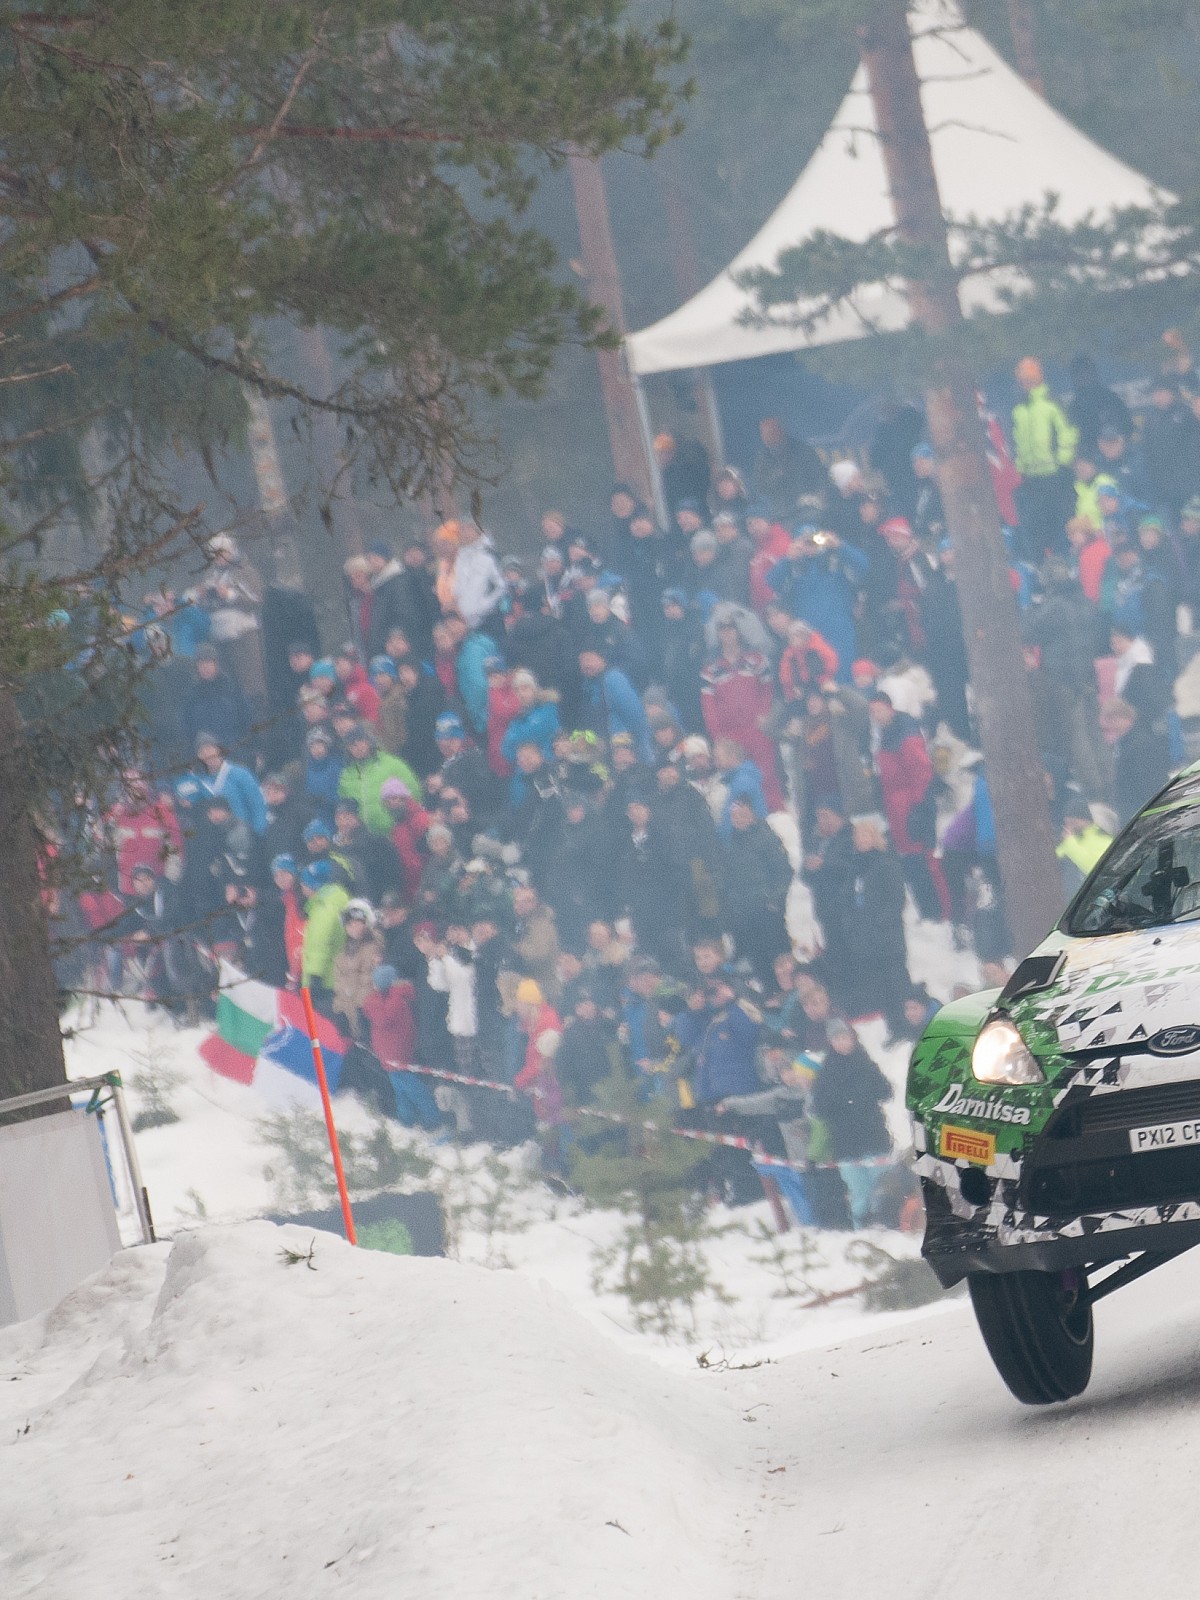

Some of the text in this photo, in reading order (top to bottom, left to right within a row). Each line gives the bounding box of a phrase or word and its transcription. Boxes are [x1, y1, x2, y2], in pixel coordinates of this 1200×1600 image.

[1160, 1029, 1198, 1047] Ford
[932, 1083, 1032, 1125] Darnitsa
[946, 1131, 990, 1160] PIRELLI
[1137, 1127, 1176, 1148] PX12
